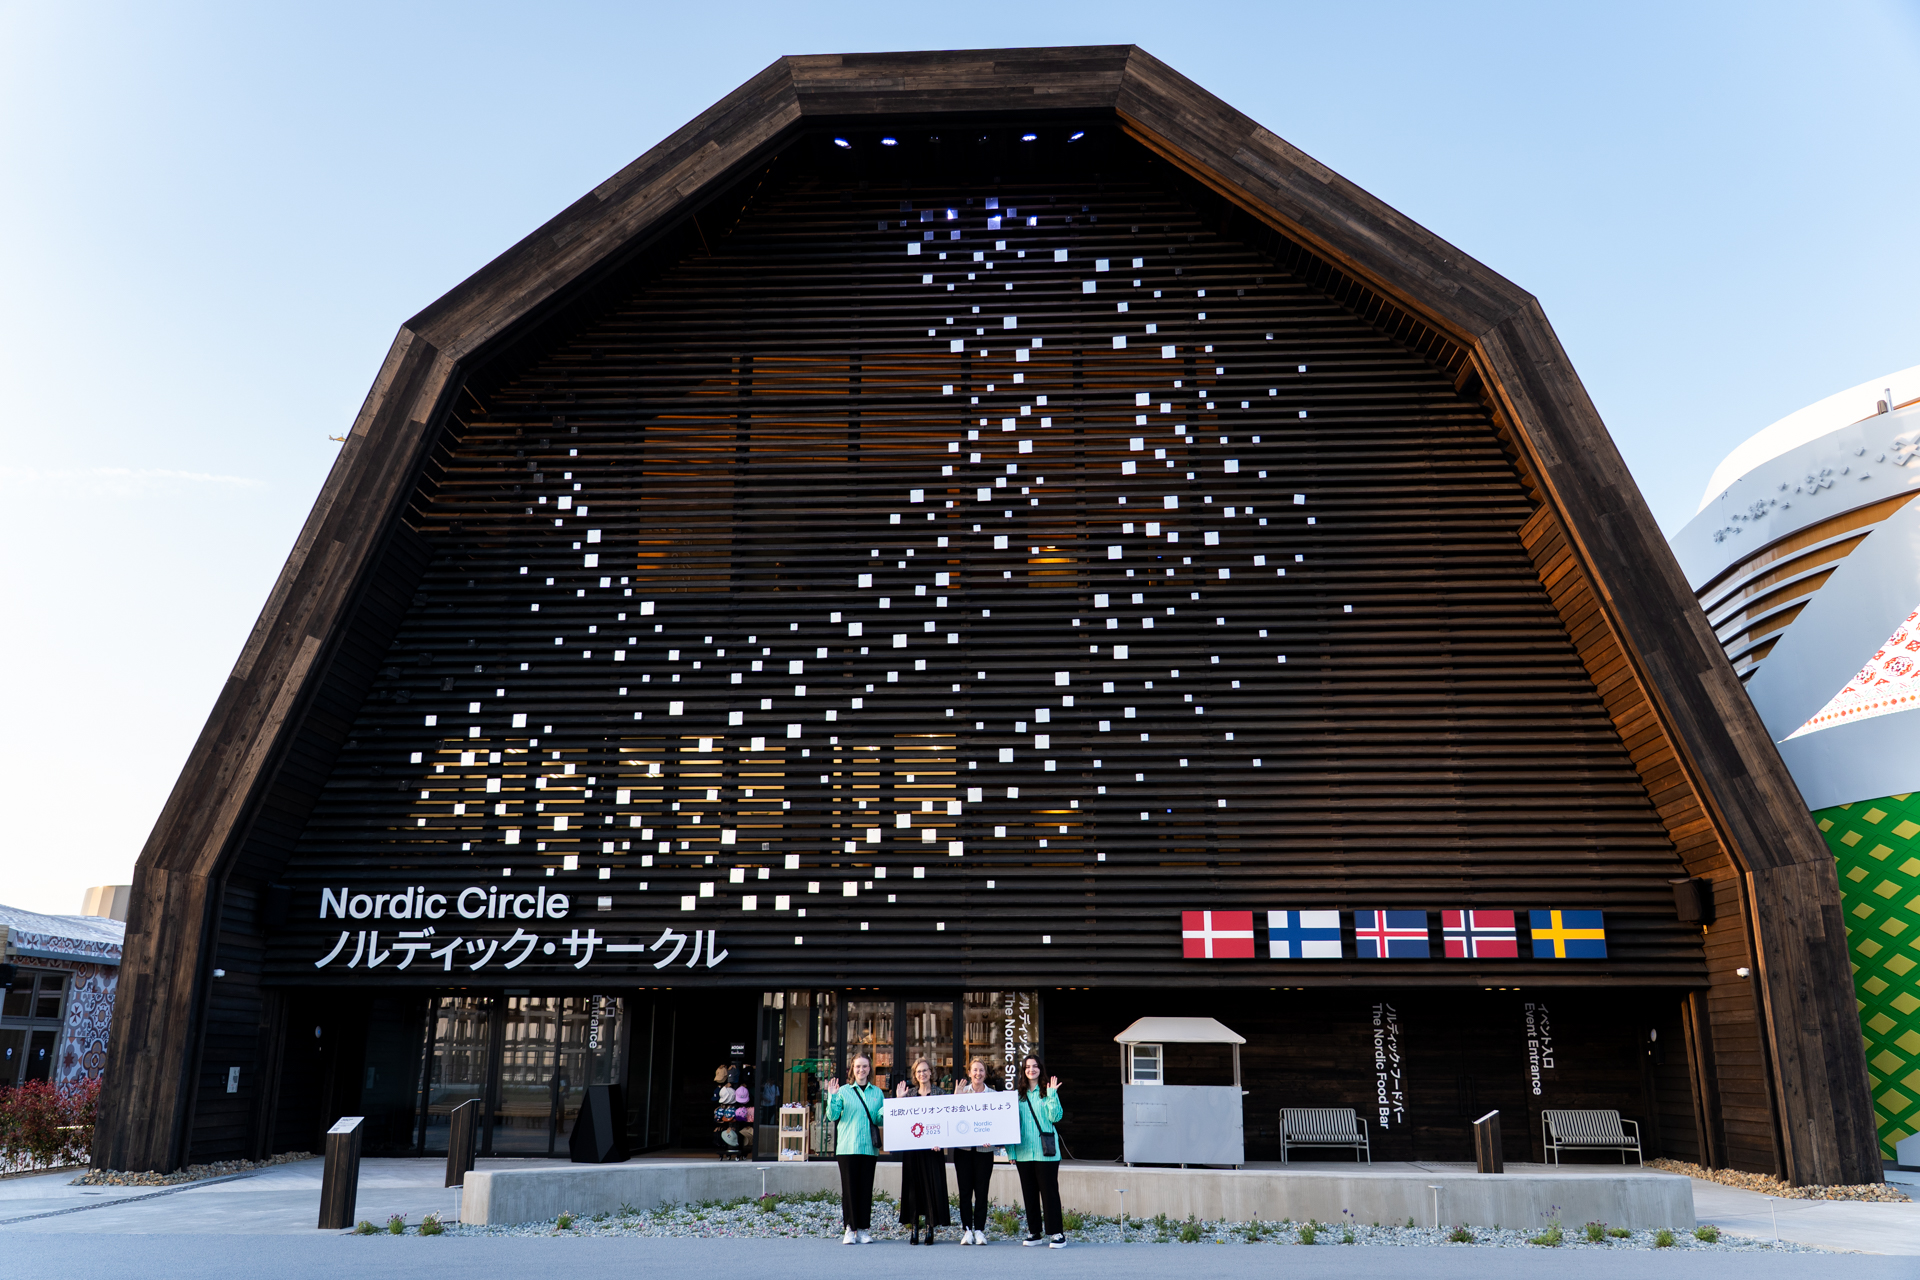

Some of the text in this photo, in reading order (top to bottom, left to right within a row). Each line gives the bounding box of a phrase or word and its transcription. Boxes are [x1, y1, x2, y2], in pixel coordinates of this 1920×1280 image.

[319, 886, 569, 919] Nordic Circle
[314, 926, 729, 971] ノルディック・サークル
[589, 994, 603, 1049] Entrance
[605, 995, 617, 1018] 入口
[1004, 991, 1016, 1091] The Nordic Sho
[1386, 1002, 1405, 1124] ノルディック・フードバー
[1524, 1002, 1542, 1096] Event Entrance
[1538, 1003, 1555, 1069] イベント入口
[1372, 1002, 1390, 1130] The Nordic Food Bar
[890, 1102, 1012, 1117] 北欧パビリオンでお会いしましょう
[973, 1120, 993, 1128] Nordic
